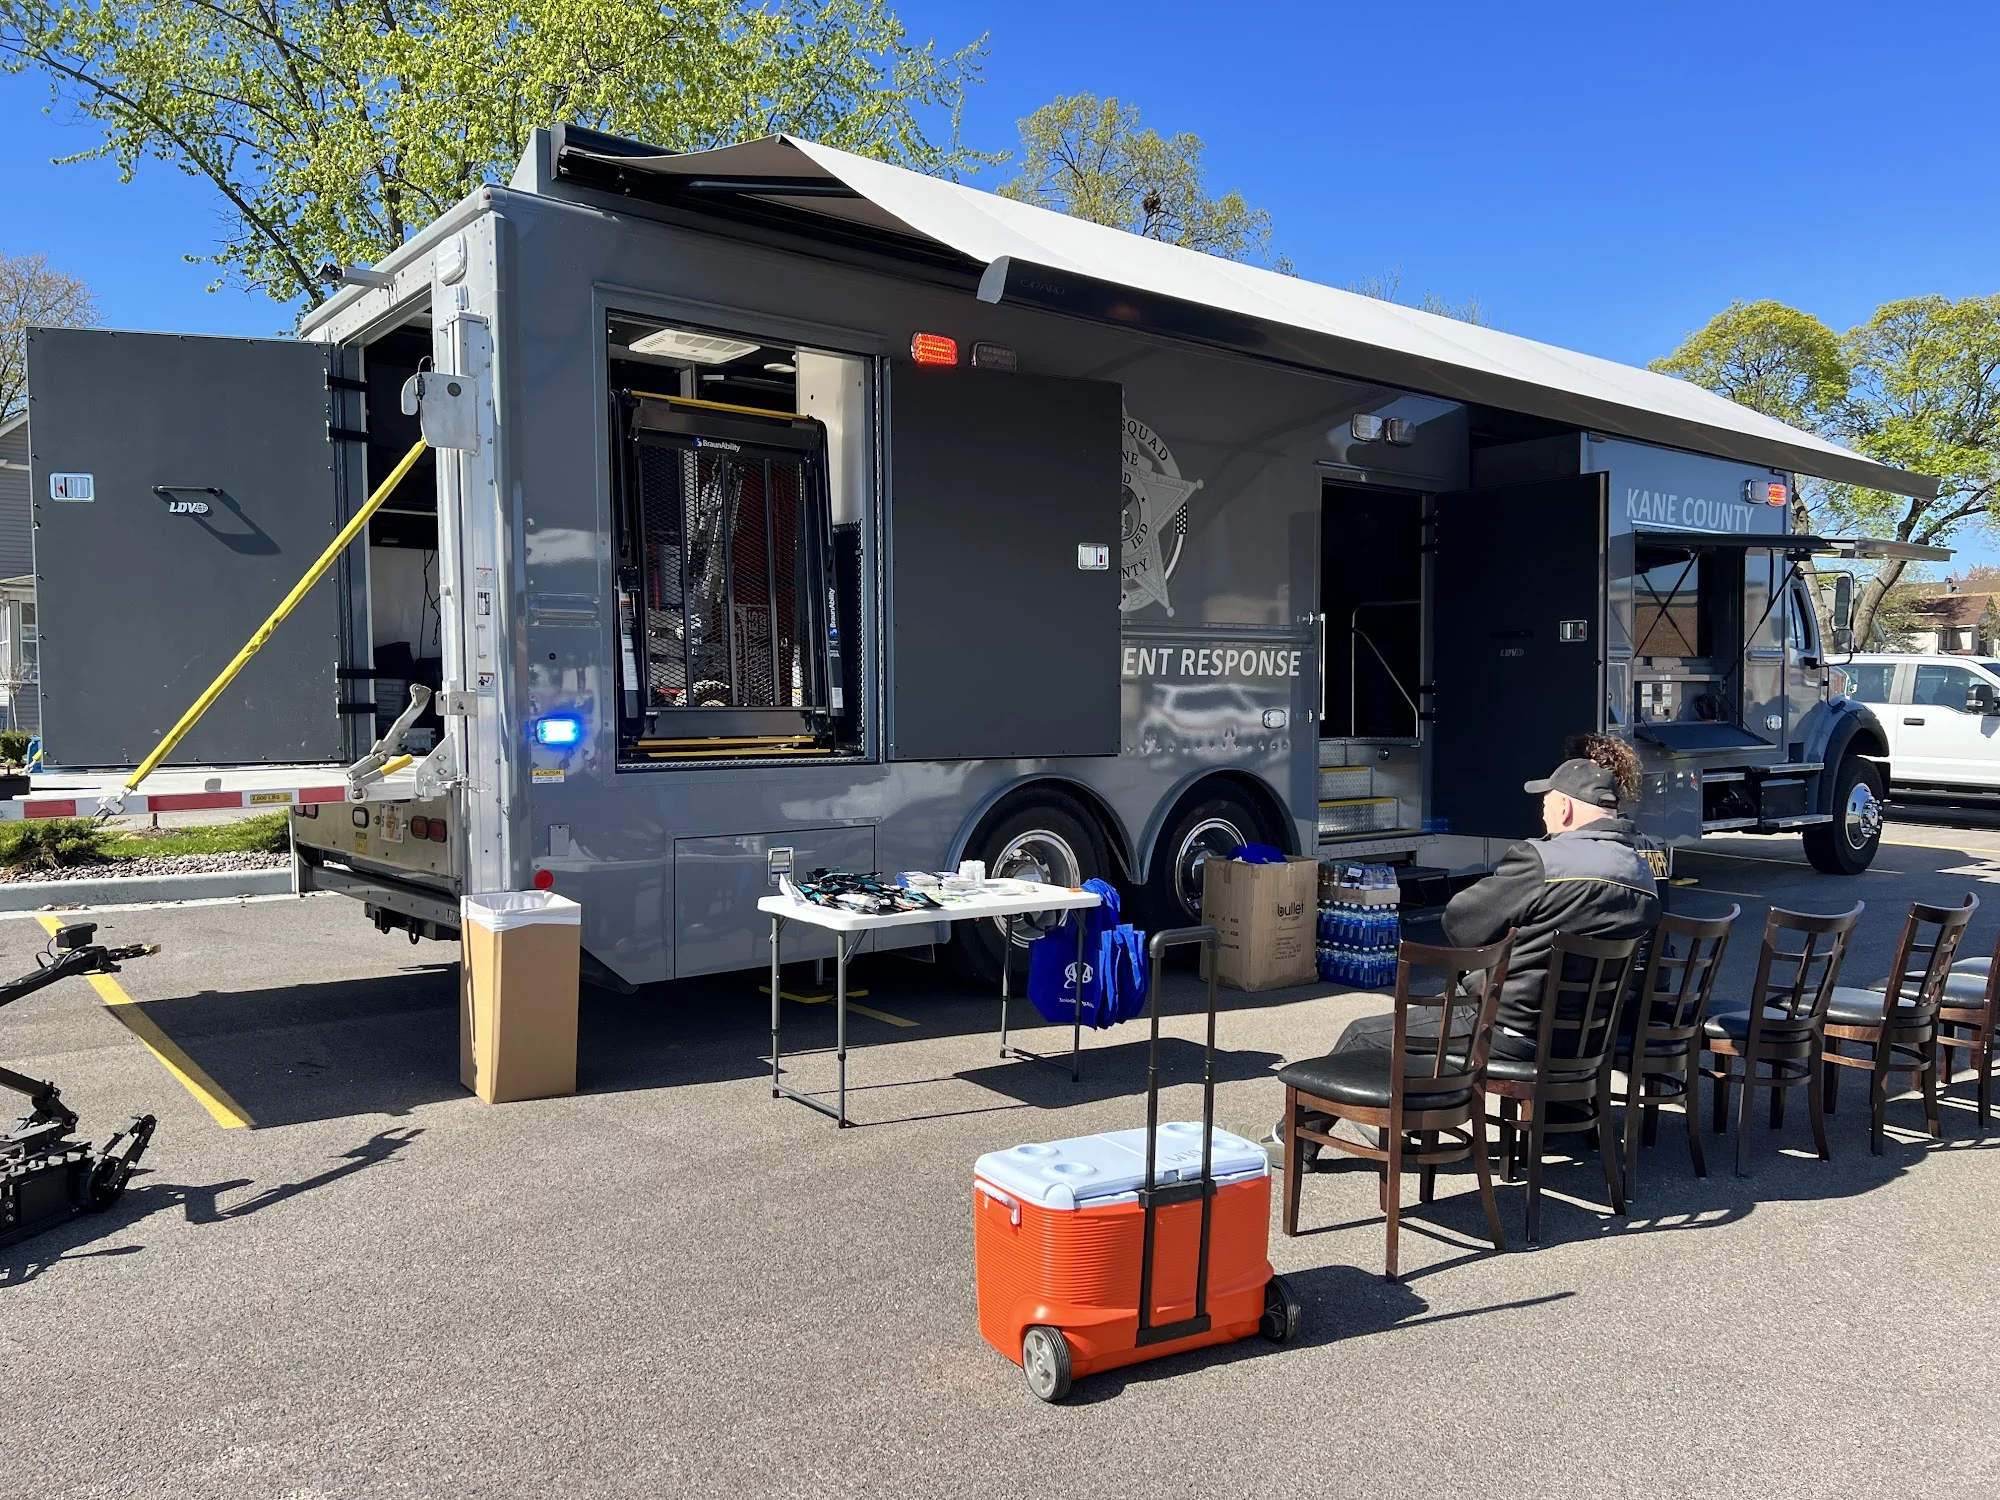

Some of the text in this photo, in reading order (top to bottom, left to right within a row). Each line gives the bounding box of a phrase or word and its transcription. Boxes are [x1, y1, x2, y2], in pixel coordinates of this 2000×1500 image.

[702, 439, 742, 453] BraunAbility
[1626, 488, 1754, 533] KANE COUNTY
[1131, 523, 1148, 549] IED
[828, 587, 836, 628] BraunAbility
[1122, 647, 1302, 677] ENT RESPONSE
[1277, 900, 1304, 917] bullet
[1065, 962, 1093, 984] AA
